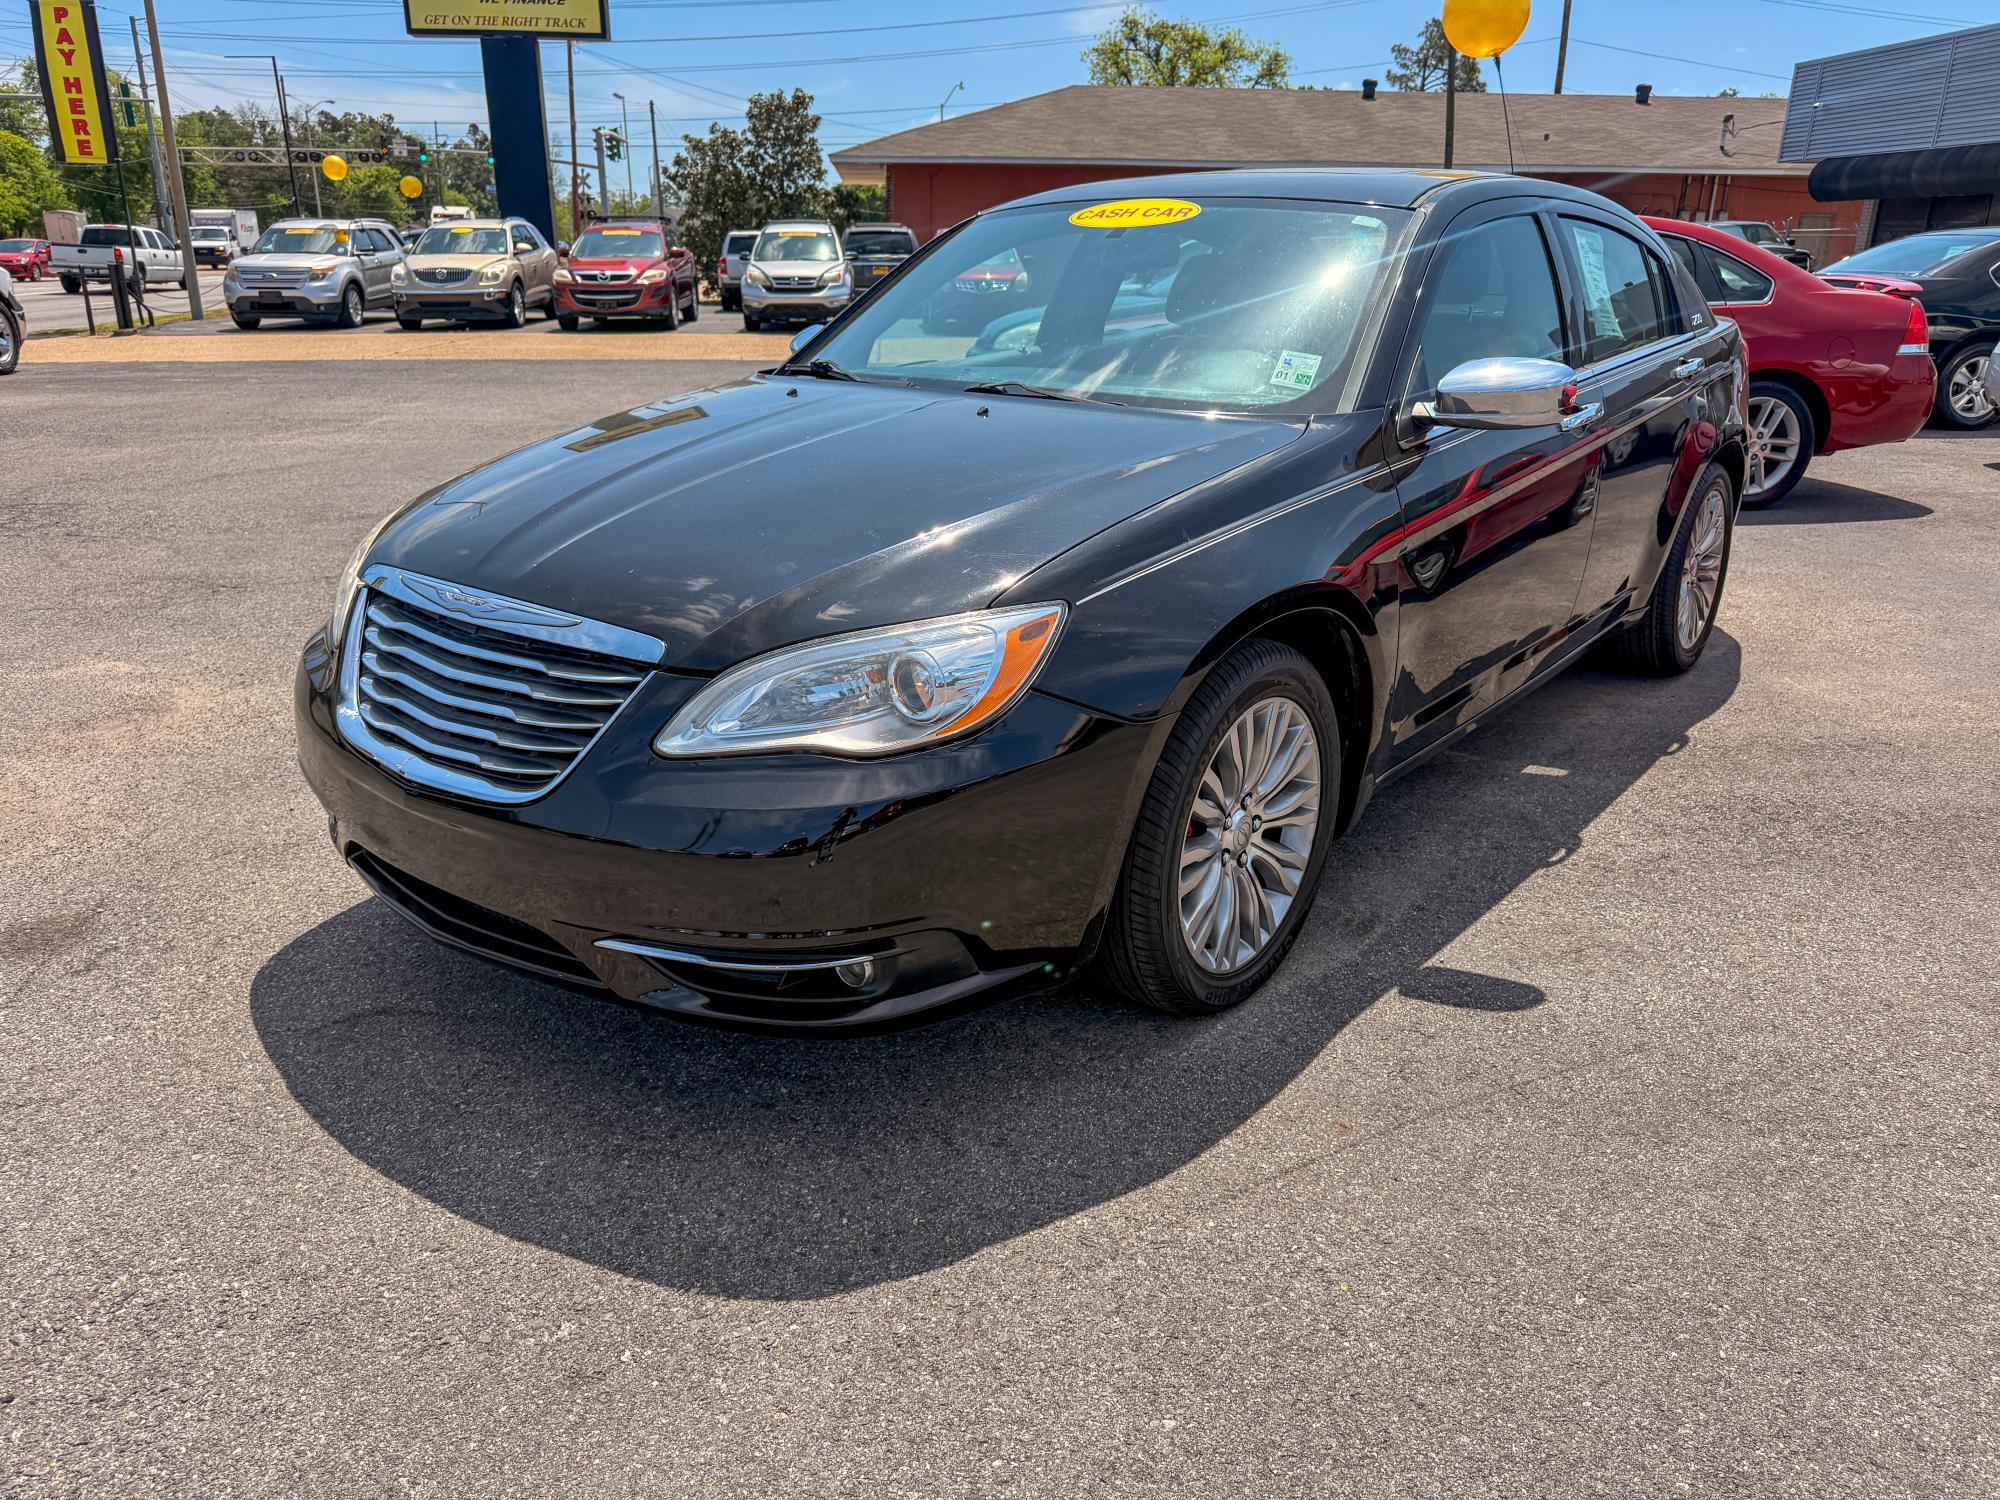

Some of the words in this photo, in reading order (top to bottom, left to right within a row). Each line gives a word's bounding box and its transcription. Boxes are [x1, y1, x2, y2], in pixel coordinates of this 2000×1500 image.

[53, 6, 76, 66] PAY
[424, 14, 449, 25] GET
[451, 15, 470, 26] ON
[474, 15, 499, 27] THE
[501, 16, 542, 28] RIGHT
[544, 17, 587, 29] TRACK
[63, 76, 93, 156] HERE
[1076, 208, 1139, 220] CASH
[1142, 207, 1193, 218] CAR
